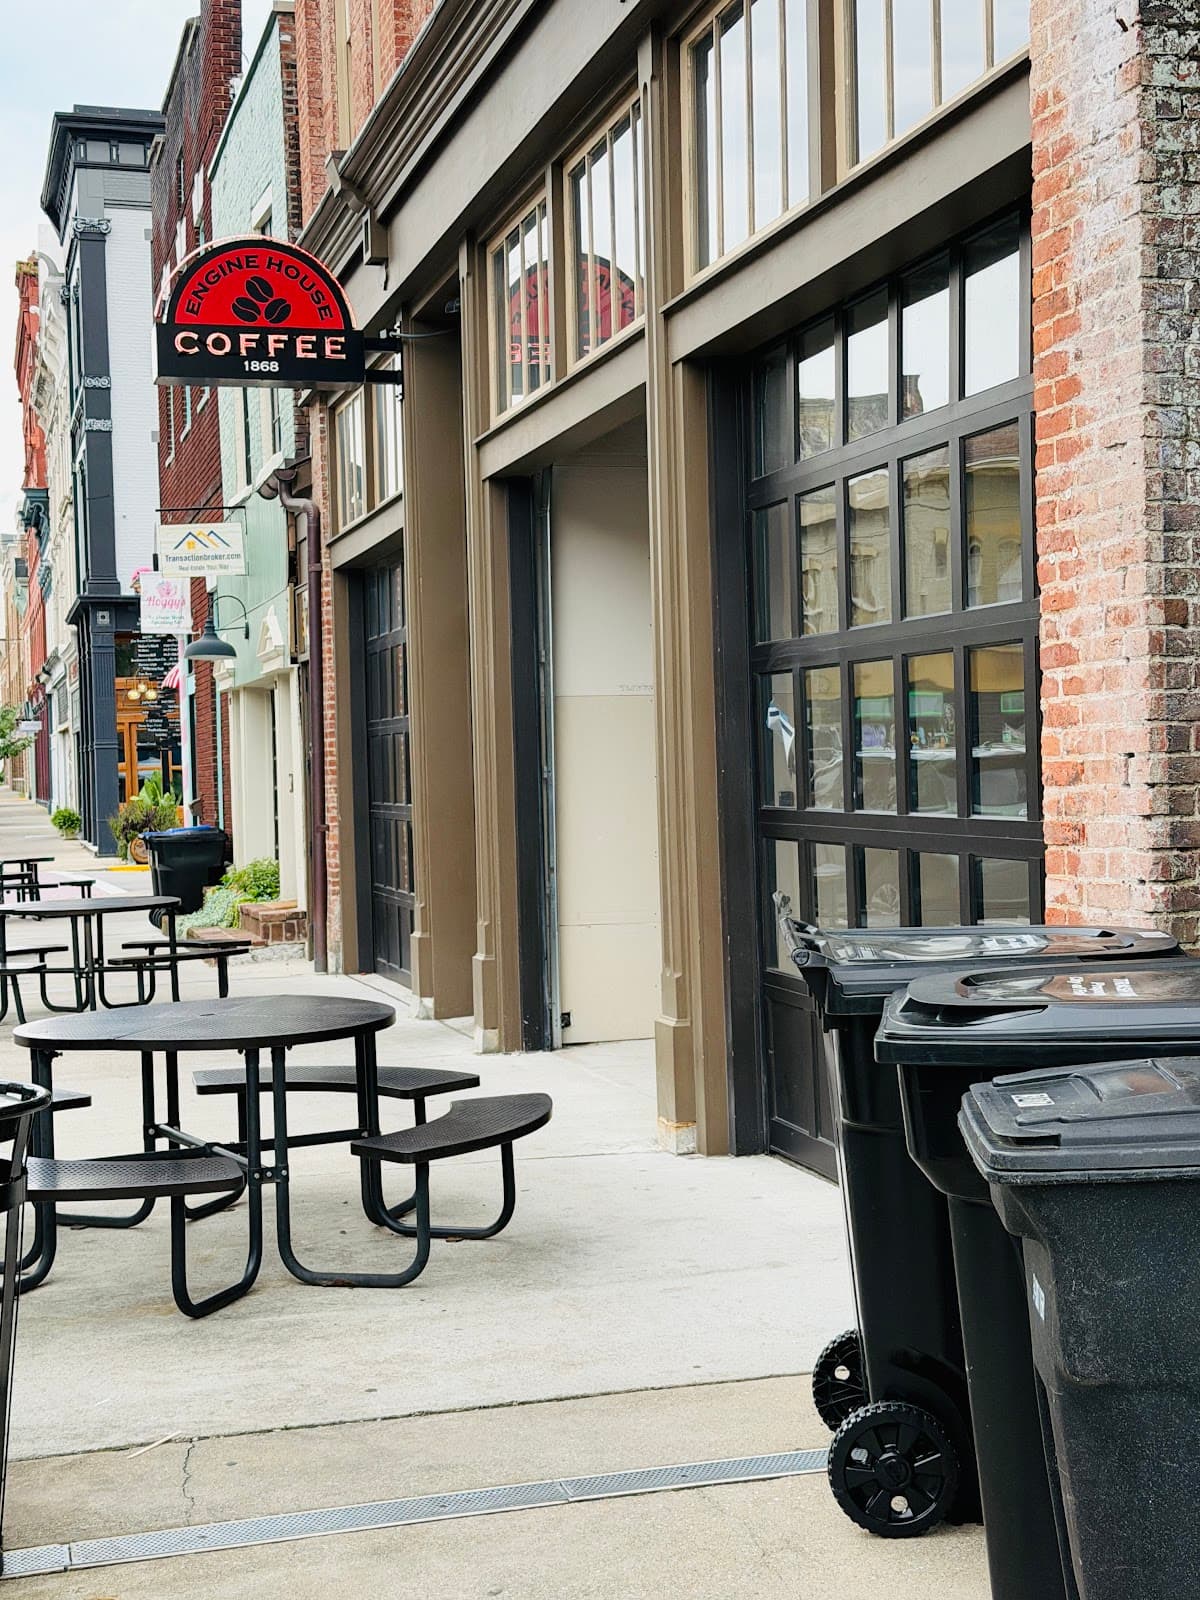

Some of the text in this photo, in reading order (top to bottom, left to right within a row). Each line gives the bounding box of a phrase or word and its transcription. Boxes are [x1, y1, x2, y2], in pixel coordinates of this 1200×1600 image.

[186, 254, 334, 321] ENGINE HOUSE
[174, 331, 347, 360] COFFEE
[243, 360, 280, 373] 1868
[165, 552, 242, 563] Transactionbroker.com
